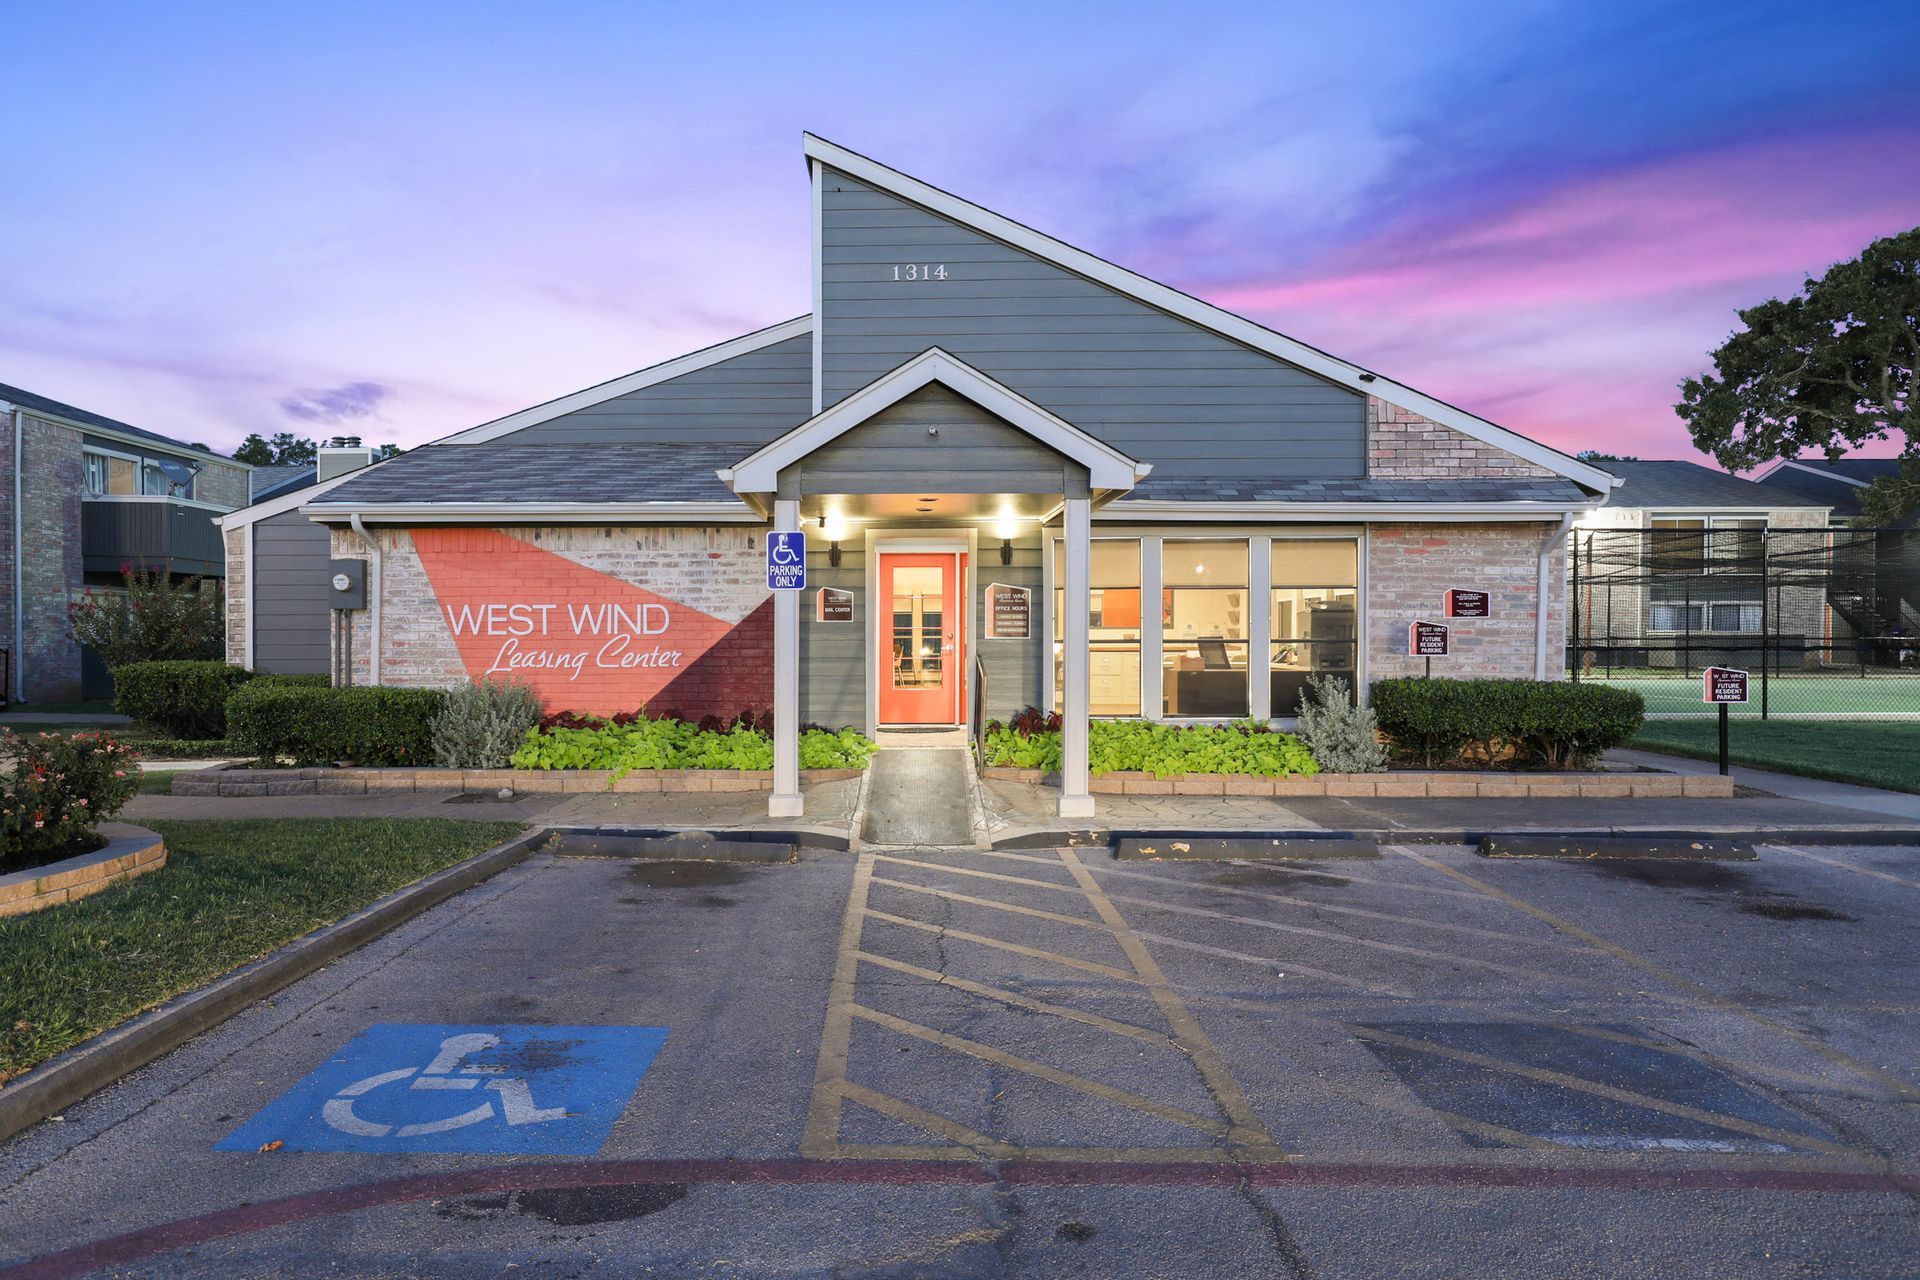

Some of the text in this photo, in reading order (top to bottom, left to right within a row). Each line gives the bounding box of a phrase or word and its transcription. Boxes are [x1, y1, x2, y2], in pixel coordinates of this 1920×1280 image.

[892, 264, 948, 280] 1314
[770, 565, 803, 576] PARKING
[775, 576, 797, 587] ONLY
[447, 603, 670, 635] WEST WIND
[485, 633, 682, 681] Leasing Center
